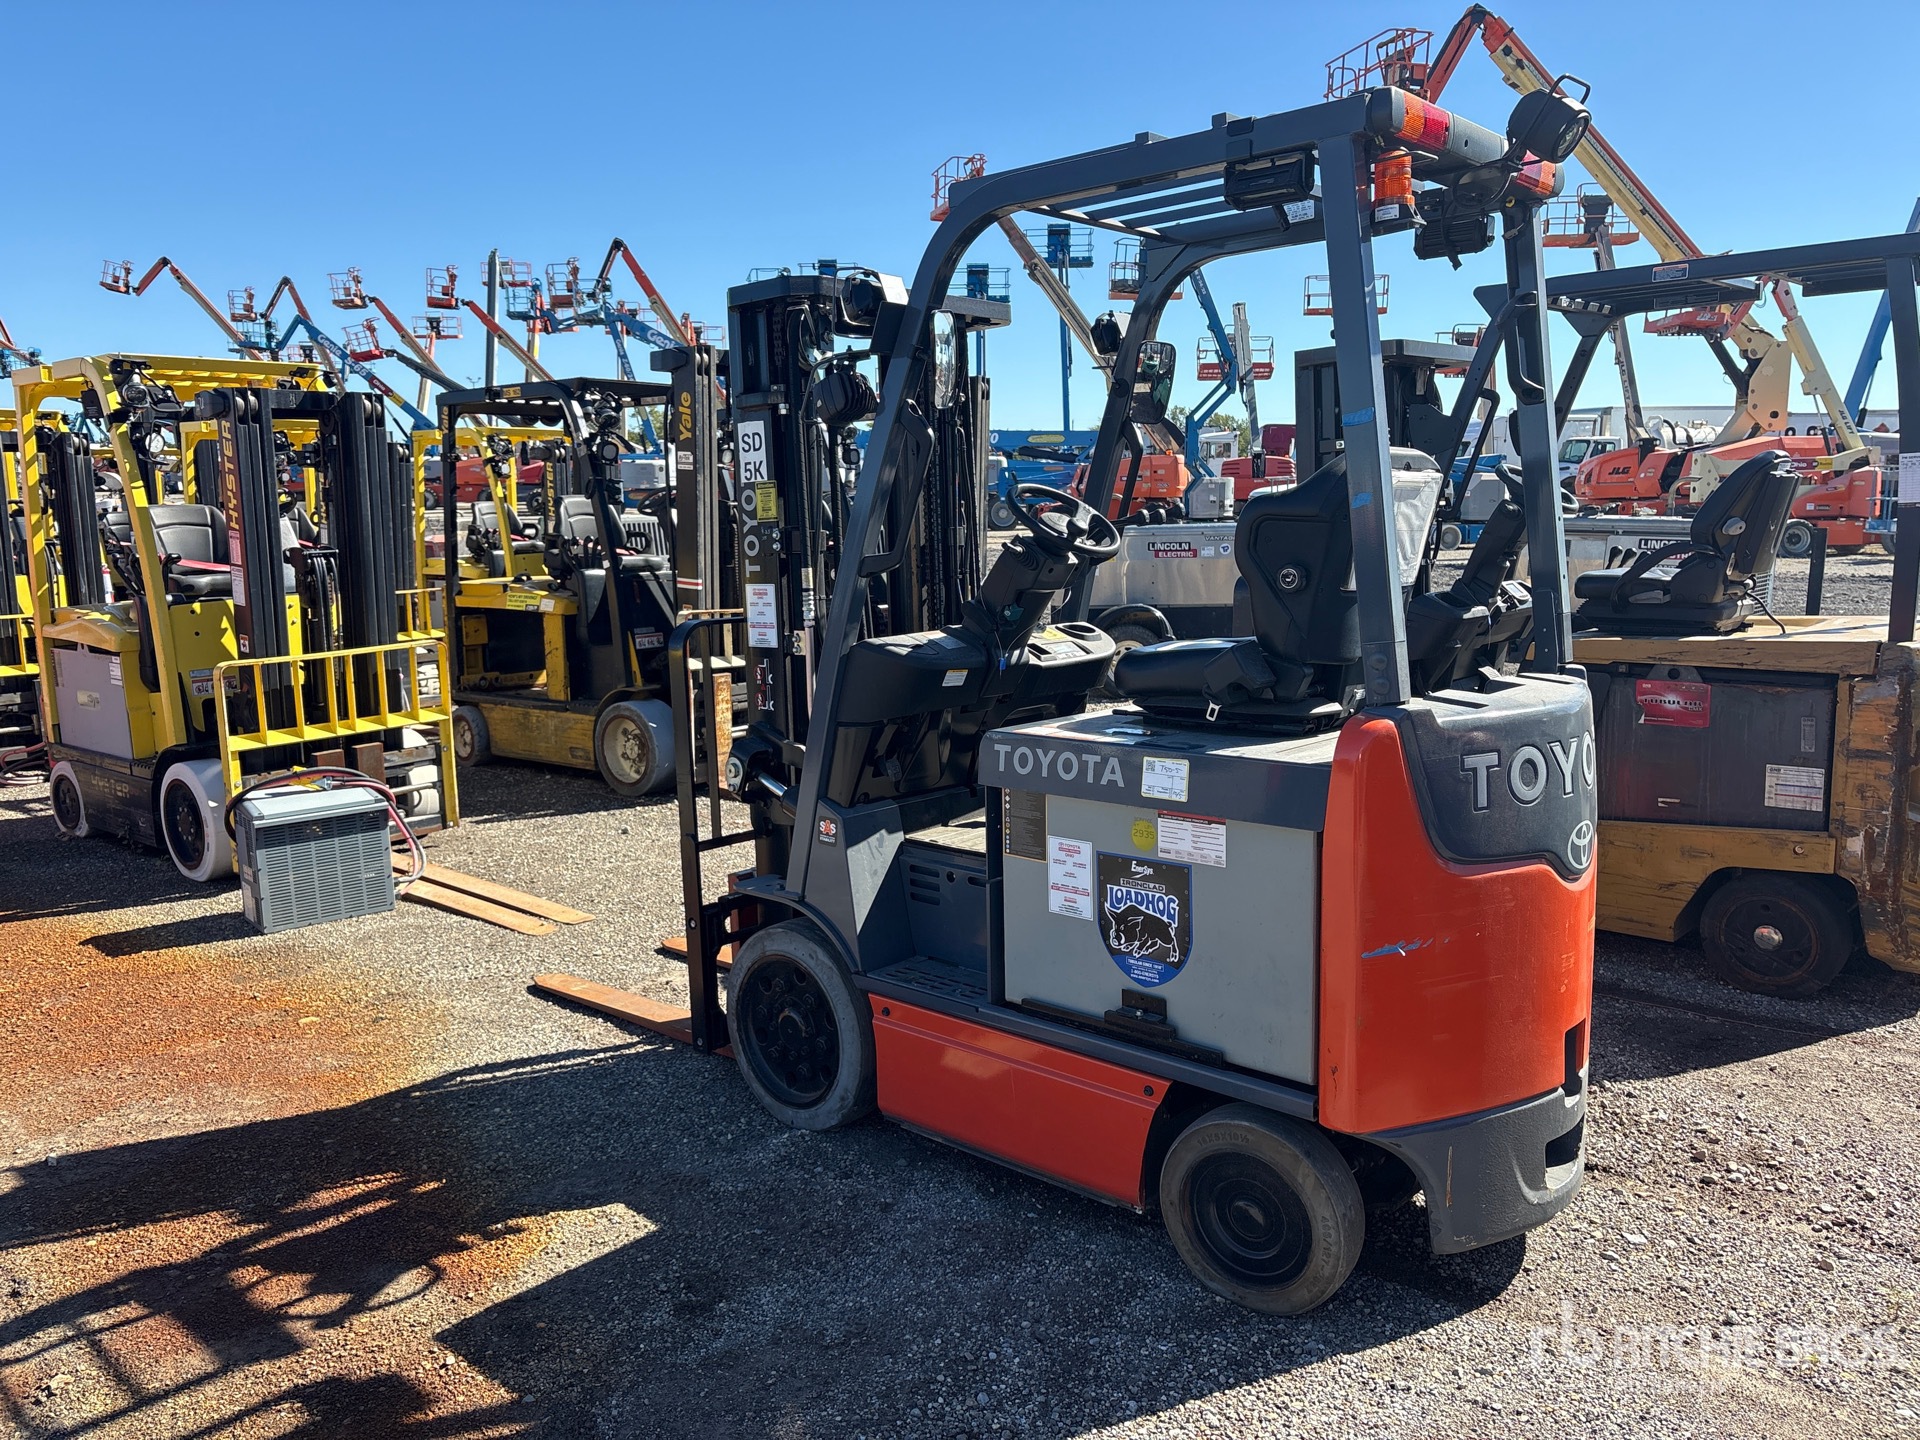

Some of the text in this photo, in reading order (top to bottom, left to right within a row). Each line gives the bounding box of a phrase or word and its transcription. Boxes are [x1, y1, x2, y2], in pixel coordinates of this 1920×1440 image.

[647, 329, 678, 350] Geni
[317, 333, 369, 377] Genie S-65
[441, 405, 449, 434] Yale
[679, 391, 692, 441] Yale
[742, 431, 763, 453] SD
[220, 420, 240, 530] HYSTER
[744, 460, 765, 482] 5K
[1608, 466, 1632, 476] JLG
[546, 461, 556, 519] HYSTER
[742, 485, 761, 577] TOYO
[1149, 542, 1190, 550] LINCOLN
[994, 743, 1125, 788] TOYOTA
[1461, 731, 1594, 812] TOYO
[819, 819, 837, 835] SAS
[1132, 828, 1155, 840] 2935
[1131, 860, 1154, 875] EnerSys
[1121, 879, 1164, 892] IRONCLAD
[1107, 885, 1179, 926] LOADHOG
